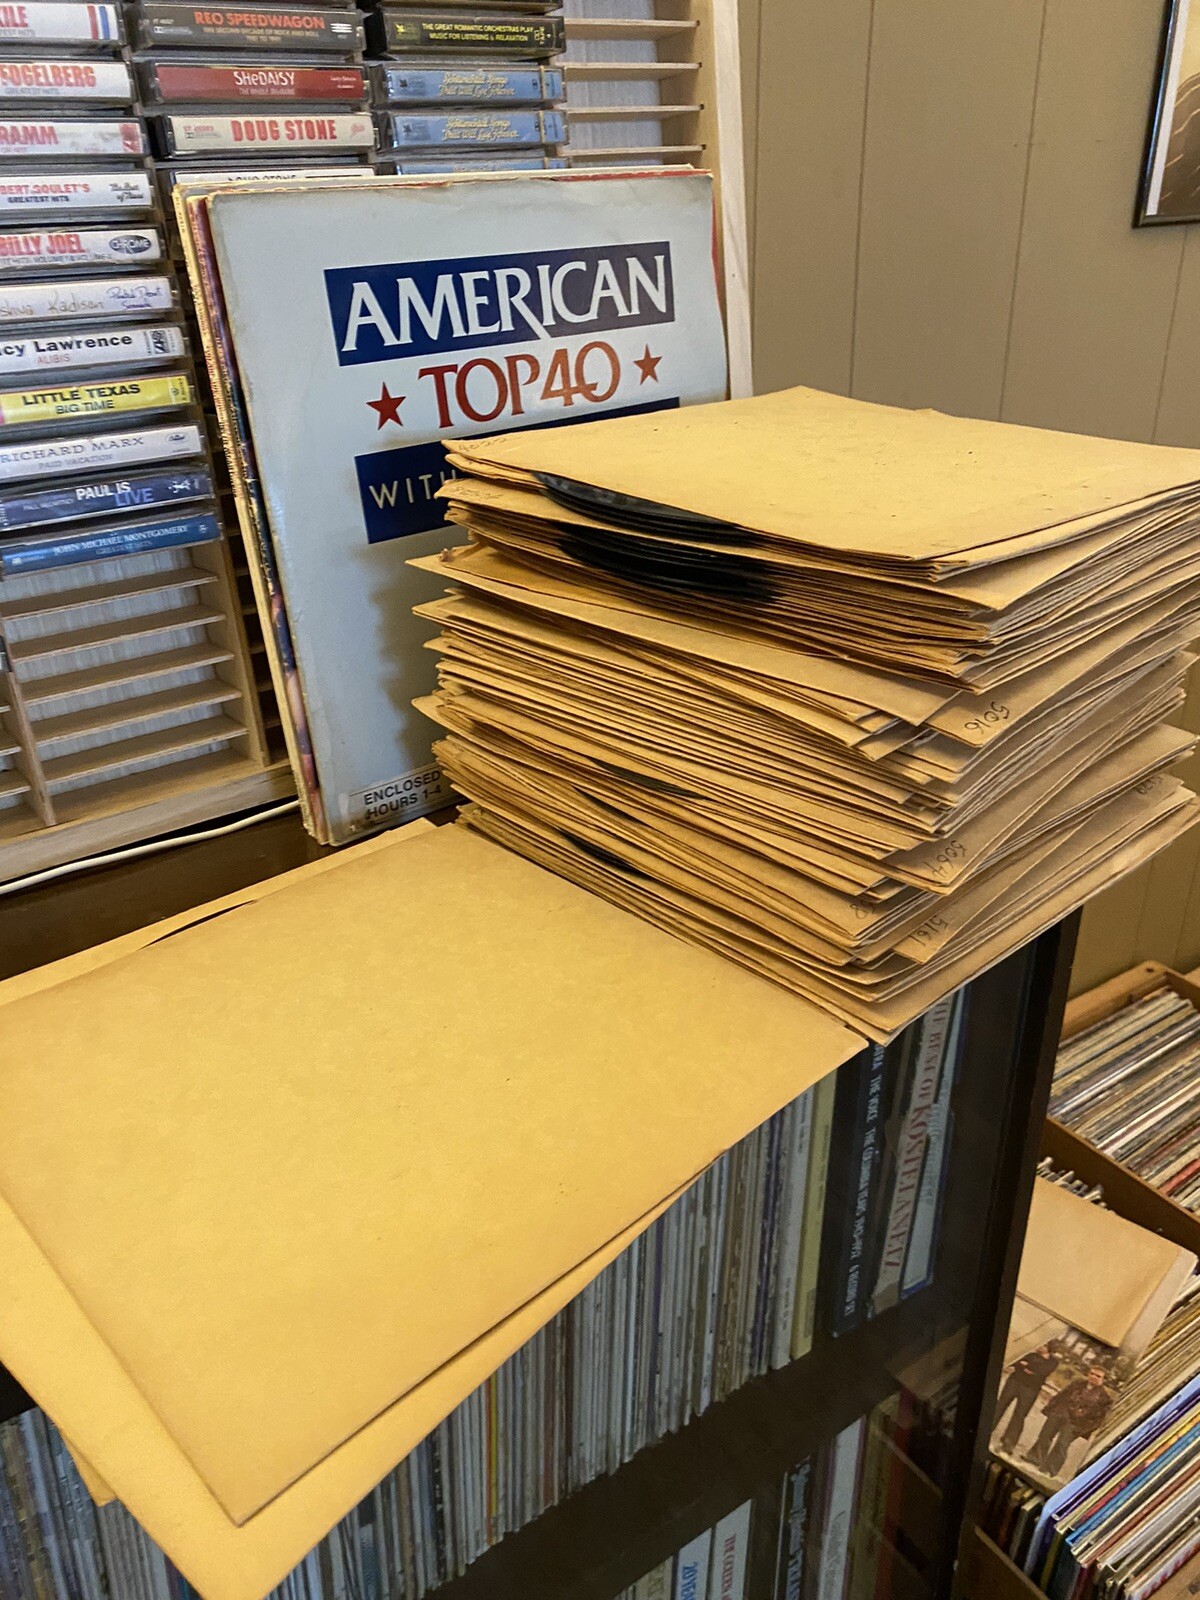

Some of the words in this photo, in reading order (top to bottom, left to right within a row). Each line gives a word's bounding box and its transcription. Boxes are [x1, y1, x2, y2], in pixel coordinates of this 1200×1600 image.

[192, 11, 224, 26] REO
[225, 13, 326, 30] SPEEDWAGON
[434, 23, 453, 31] GREAT
[454, 24, 483, 32] ROMANTIC
[483, 25, 519, 33] ORCHESTRAS
[429, 32, 448, 40] MUSIC
[495, 34, 528, 42] RELAXATION
[231, 120, 280, 142] DOUG
[285, 119, 338, 141] STONE
[46, 233, 86, 255] JOEL
[340, 254, 667, 352] AMERICAN
[0, 344, 25, 357] cy
[34, 335, 133, 352] Lawrence
[37, 353, 71, 365] ALIBIS
[22, 388, 82, 406] LITTLE
[86, 384, 141, 399] TEXAS
[55, 403, 80, 414] BIG
[83, 400, 115, 411] TIME
[0, 444, 86, 464] RICHARD
[91, 436, 145, 452] MARX
[75, 484, 114, 501] PAUL
[115, 481, 132, 494] IS
[113, 487, 155, 508] LIVE
[53, 543, 80, 556] JOHN
[80, 536, 124, 550] MICHAEL
[124, 524, 190, 542] MONTGOMERY
[963, 701, 1010, 735] 5016
[364, 770, 441, 805] ENCLOSED
[365, 792, 418, 820] HOURS
[884, 1102, 934, 1269] KOSTELANETZ
